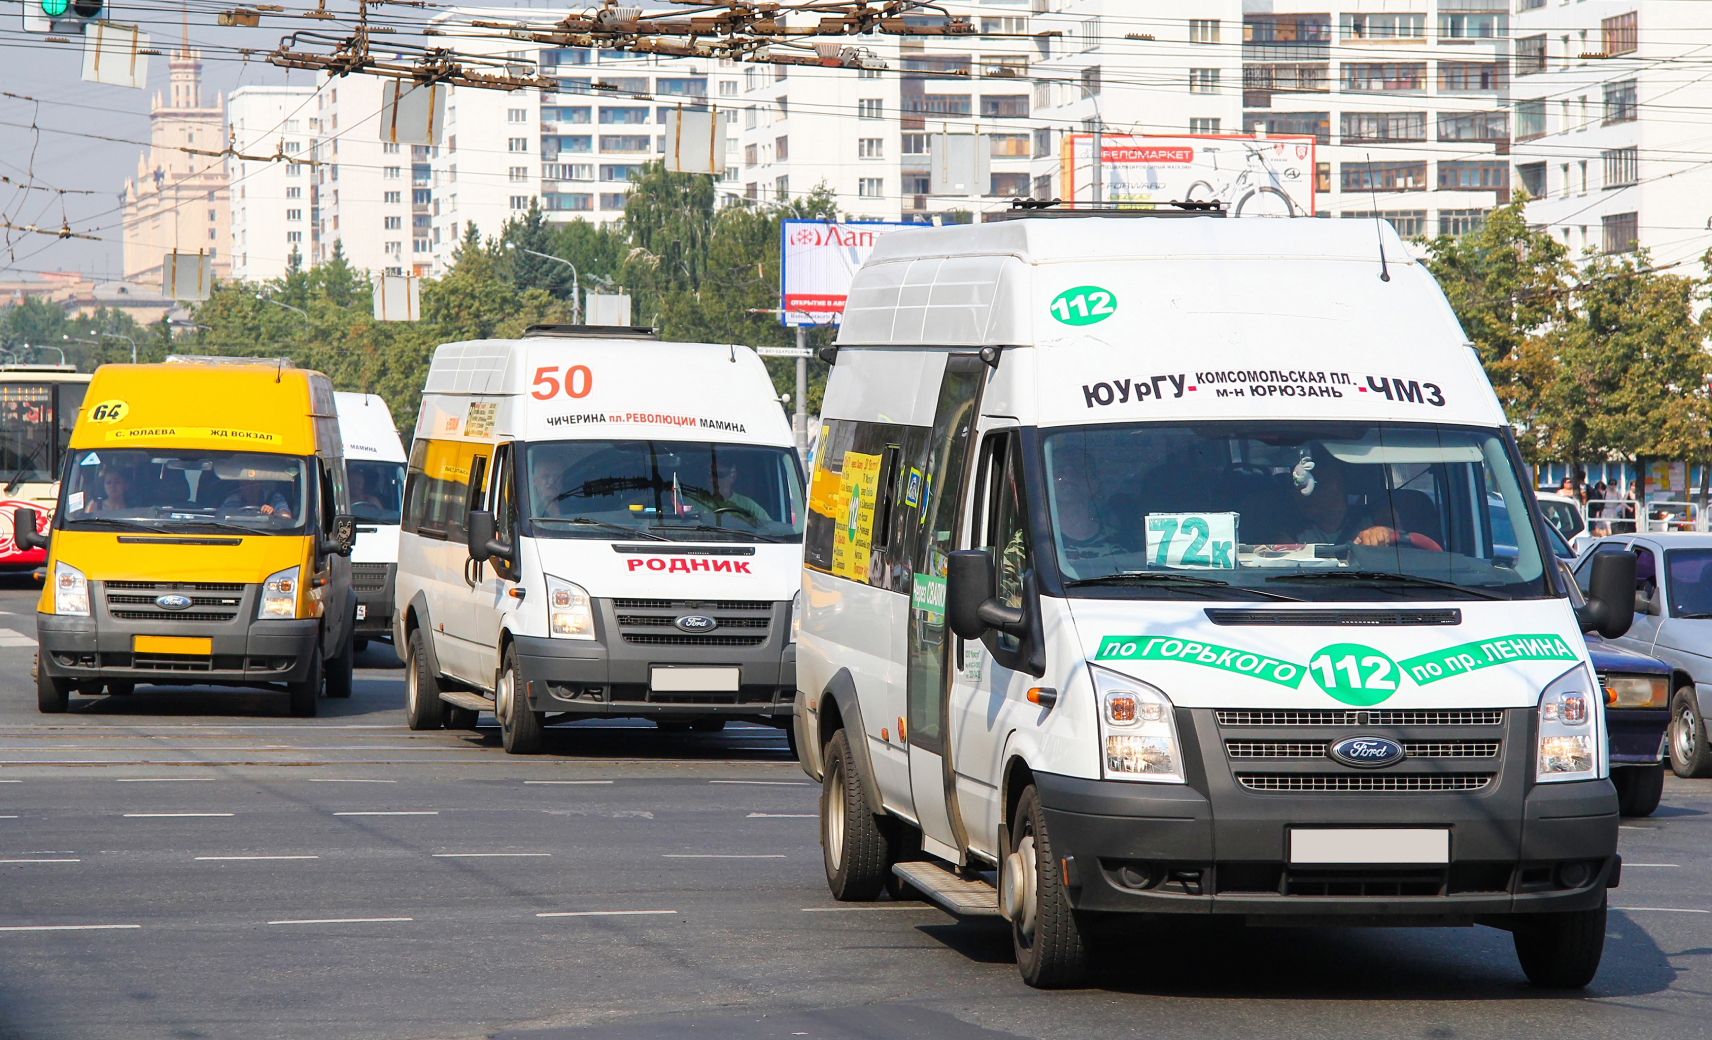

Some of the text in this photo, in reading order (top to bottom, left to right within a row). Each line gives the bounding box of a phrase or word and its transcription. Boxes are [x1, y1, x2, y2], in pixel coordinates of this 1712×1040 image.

[1050, 291, 1115, 321] 112
[530, 364, 593, 401] 50
[1195, 370, 1358, 386] КОМСОМОЛЬСКАЯ ПЛ.
[1215, 384, 1343, 398] м-н ЮРЮЗАНЬ
[1366, 375, 1446, 407] ЧМЗ
[92, 403, 122, 421] 64
[546, 413, 607, 427] ЧИЧЕРИНА
[699, 418, 747, 434] МАМИНА
[210, 429, 228, 437] ЖД
[231, 431, 273, 441] ВОКЗАЛ
[627, 558, 752, 575] РОДНИК
[163, 594, 184, 606] Ford
[685, 617, 707, 627] Ford
[1102, 638, 1297, 682] по ГОРЬКОГО
[1410, 638, 1574, 681] по пр. ЛЕНИНА
[1310, 654, 1397, 691] 112
[1350, 741, 1388, 757] Ford
